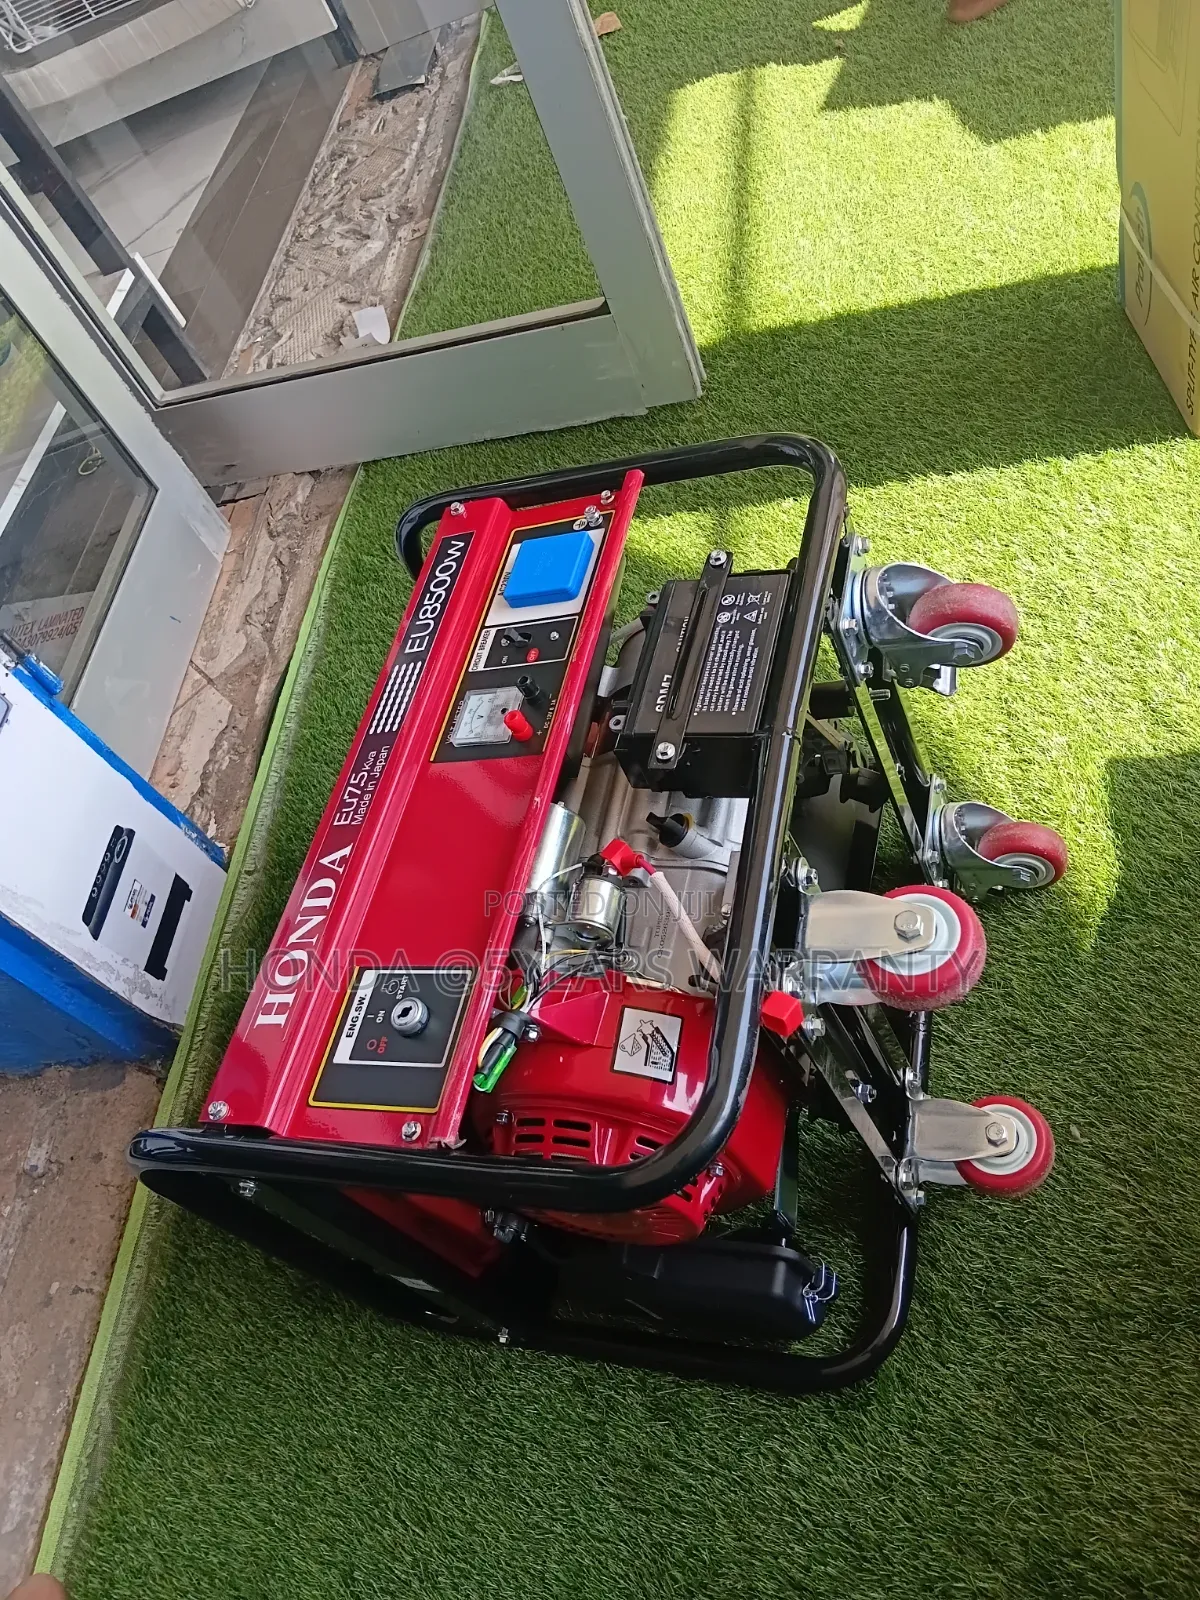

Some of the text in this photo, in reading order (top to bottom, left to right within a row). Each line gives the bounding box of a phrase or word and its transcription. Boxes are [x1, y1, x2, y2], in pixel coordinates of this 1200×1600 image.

[38, 606, 84, 631] LAMINATED
[470, 629, 491, 670] CIRCUIT BREAKER
[500, 654, 509, 664] ON
[527, 649, 537, 661] OFF
[350, 744, 391, 826] Made in Japan
[254, 844, 353, 1029] HONDA
[395, 974, 409, 999] START
[344, 993, 367, 1037] ENG.SW.
[375, 1010, 386, 1022] ON
[376, 1036, 389, 1053] OFF
